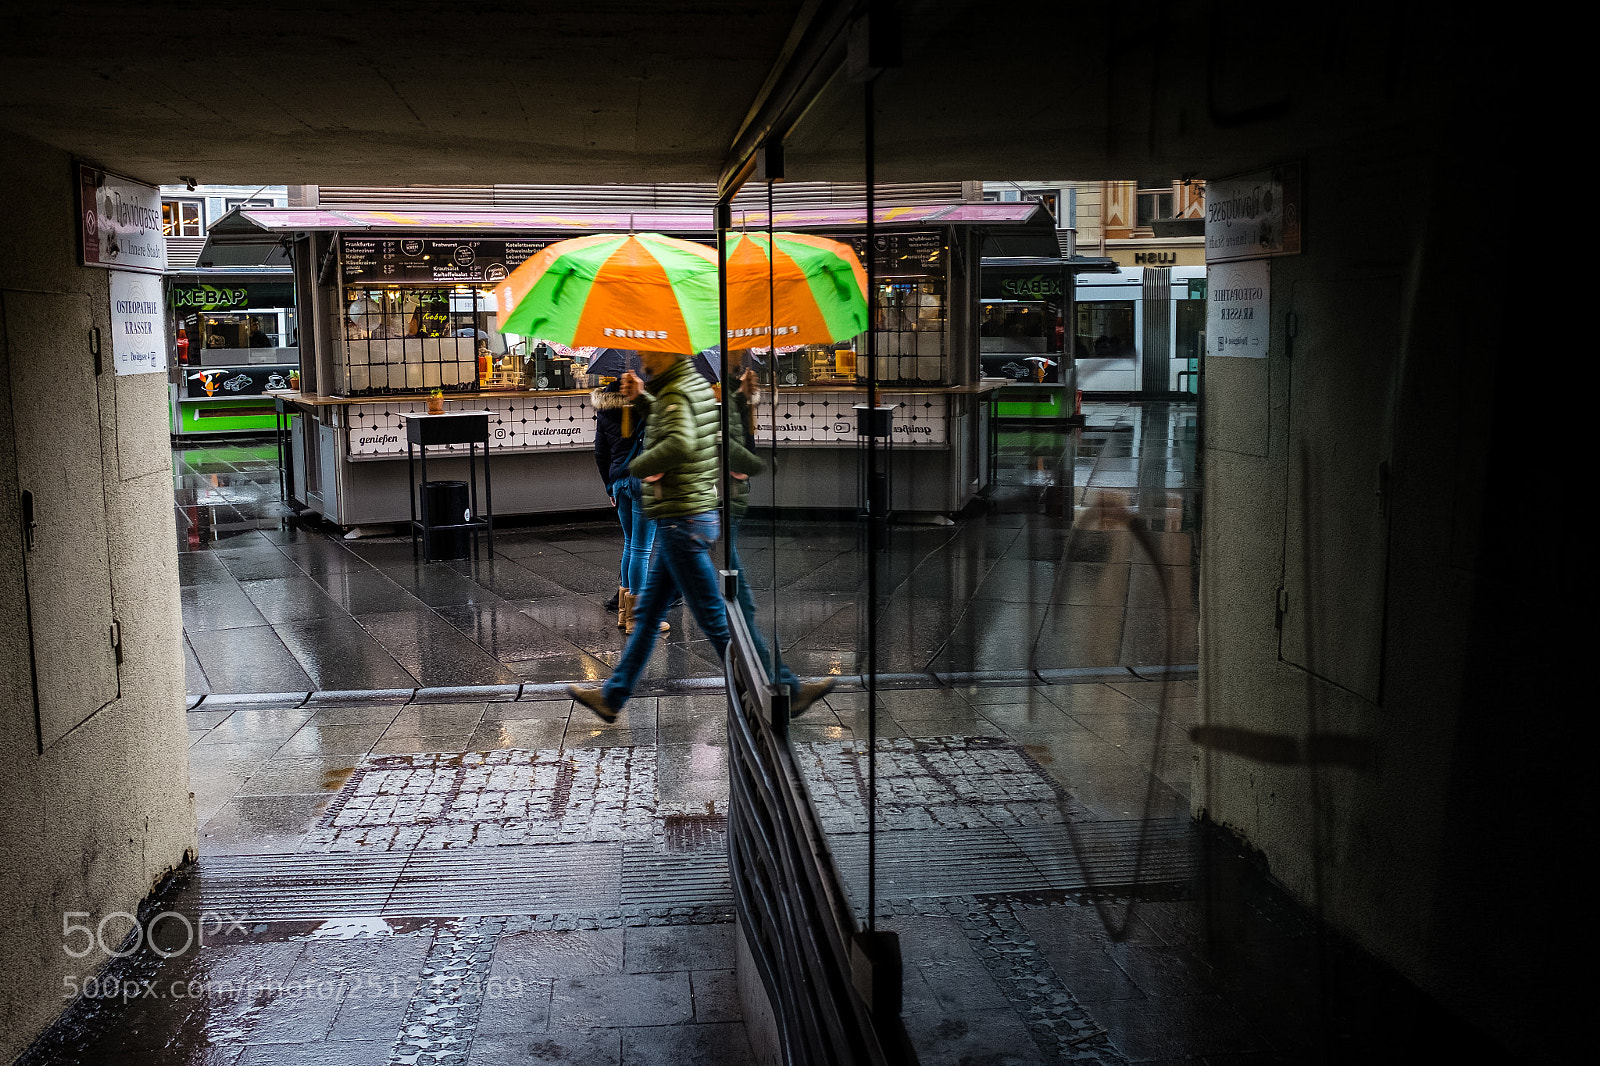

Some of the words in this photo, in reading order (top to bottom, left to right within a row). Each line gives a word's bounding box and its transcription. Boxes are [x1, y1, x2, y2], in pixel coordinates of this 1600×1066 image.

[114, 191, 159, 236] Davidgasse
[178, 288, 246, 306] KEBAP
[116, 300, 158, 315] OSTEOPATHIE
[422, 311, 448, 324] Kebap
[124, 321, 153, 335] KRASSER
[531, 427, 581, 437] weitersagen
[359, 434, 398, 447] genießen
